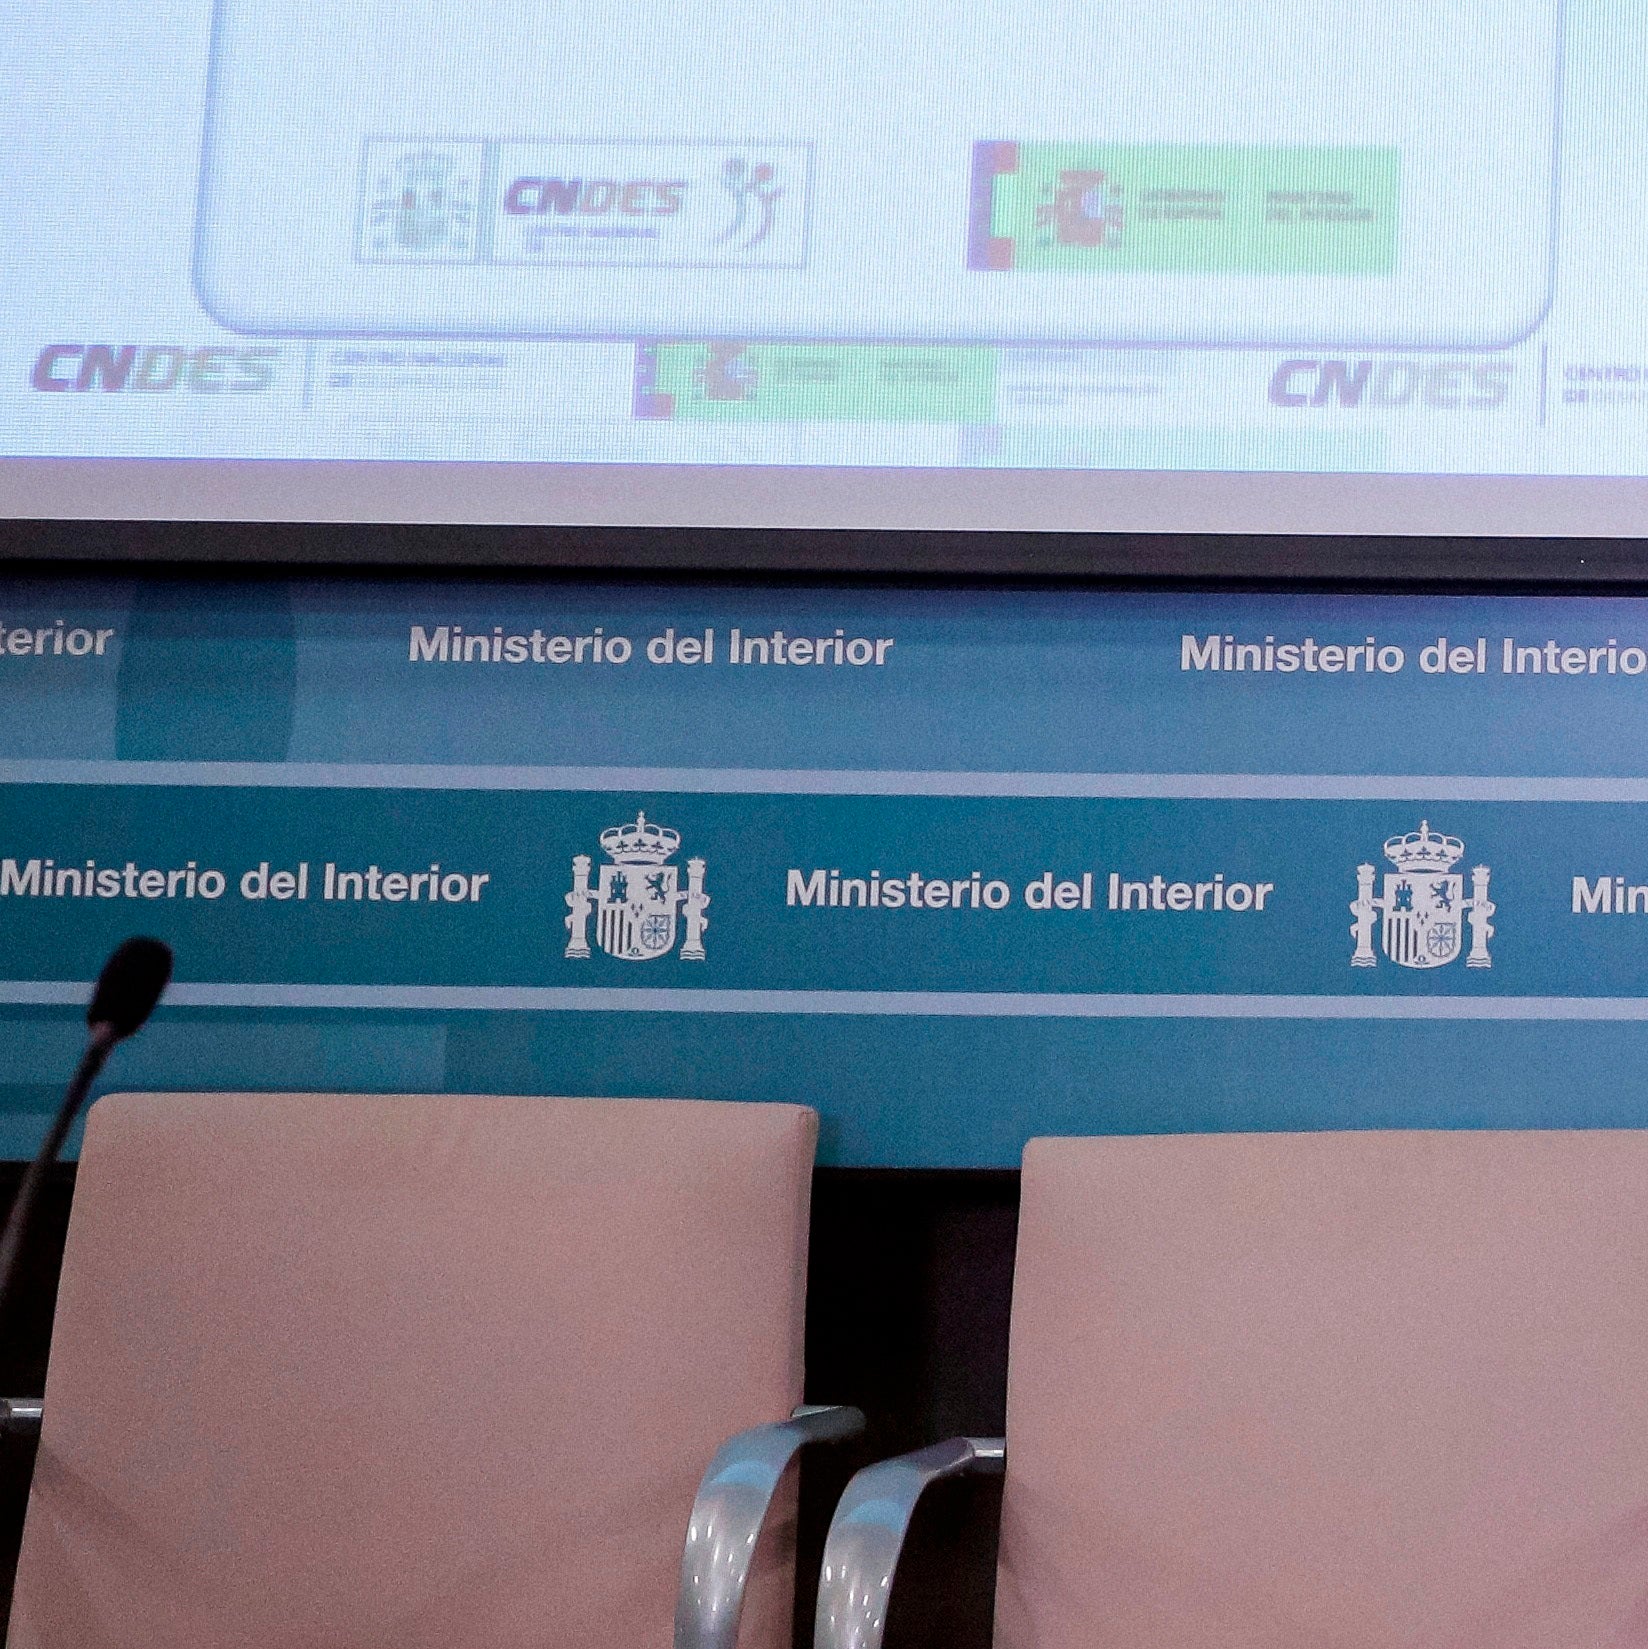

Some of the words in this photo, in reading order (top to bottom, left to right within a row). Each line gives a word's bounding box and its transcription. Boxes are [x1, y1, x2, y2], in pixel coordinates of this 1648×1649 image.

[502, 175, 689, 217] CNDES
[29, 342, 281, 394] CNDES
[1268, 357, 1514, 410] CNDES
[410, 626, 633, 665] Ministerio
[647, 628, 715, 665] del
[730, 629, 895, 667] Interior
[1181, 635, 1405, 674] Ministerio
[1419, 638, 1487, 675] del
[0, 859, 227, 901] Ministerio
[241, 862, 309, 902] del
[323, 863, 491, 904] Interior
[788, 869, 1011, 910] Ministerio
[1025, 872, 1094, 911] del
[1109, 873, 1275, 912] Interior
